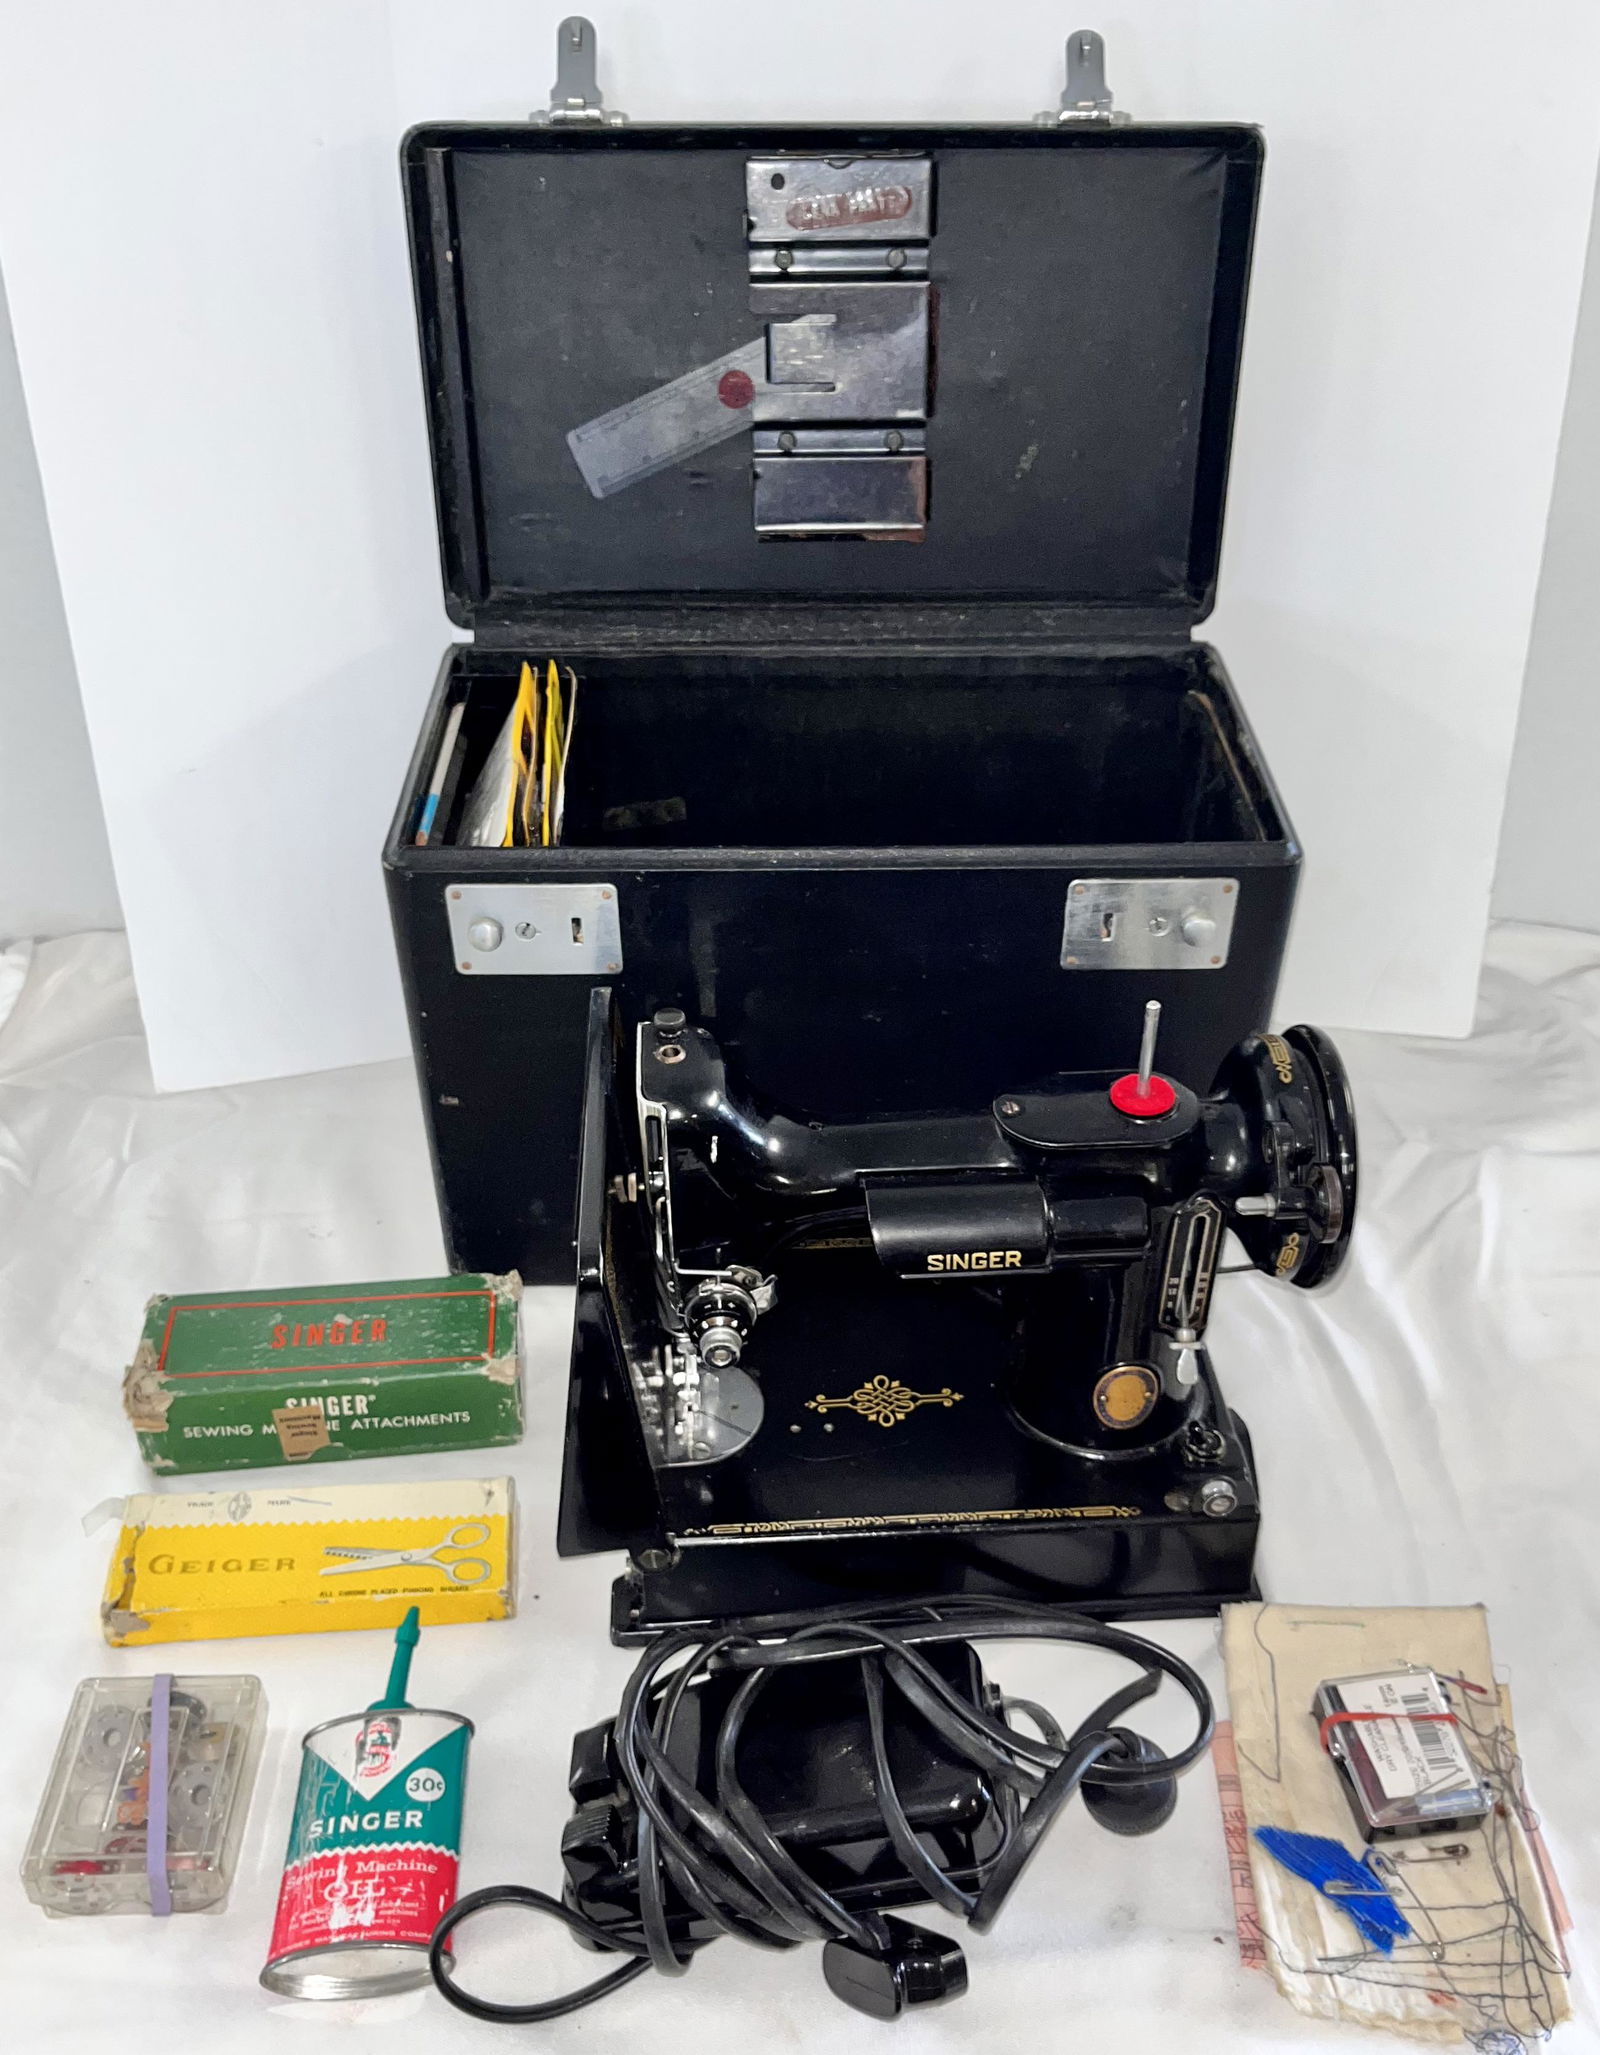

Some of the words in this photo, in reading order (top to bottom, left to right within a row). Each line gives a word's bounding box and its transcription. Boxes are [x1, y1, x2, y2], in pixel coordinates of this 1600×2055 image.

[927, 1250, 1022, 1271] SINGER
[271, 1318, 388, 1349] SINGER
[183, 1423, 254, 1439] SEWING
[351, 1411, 471, 1431] ATTACHMENTS
[308, 1809, 424, 1839] SINGER
[354, 1858, 438, 1874] Machine
